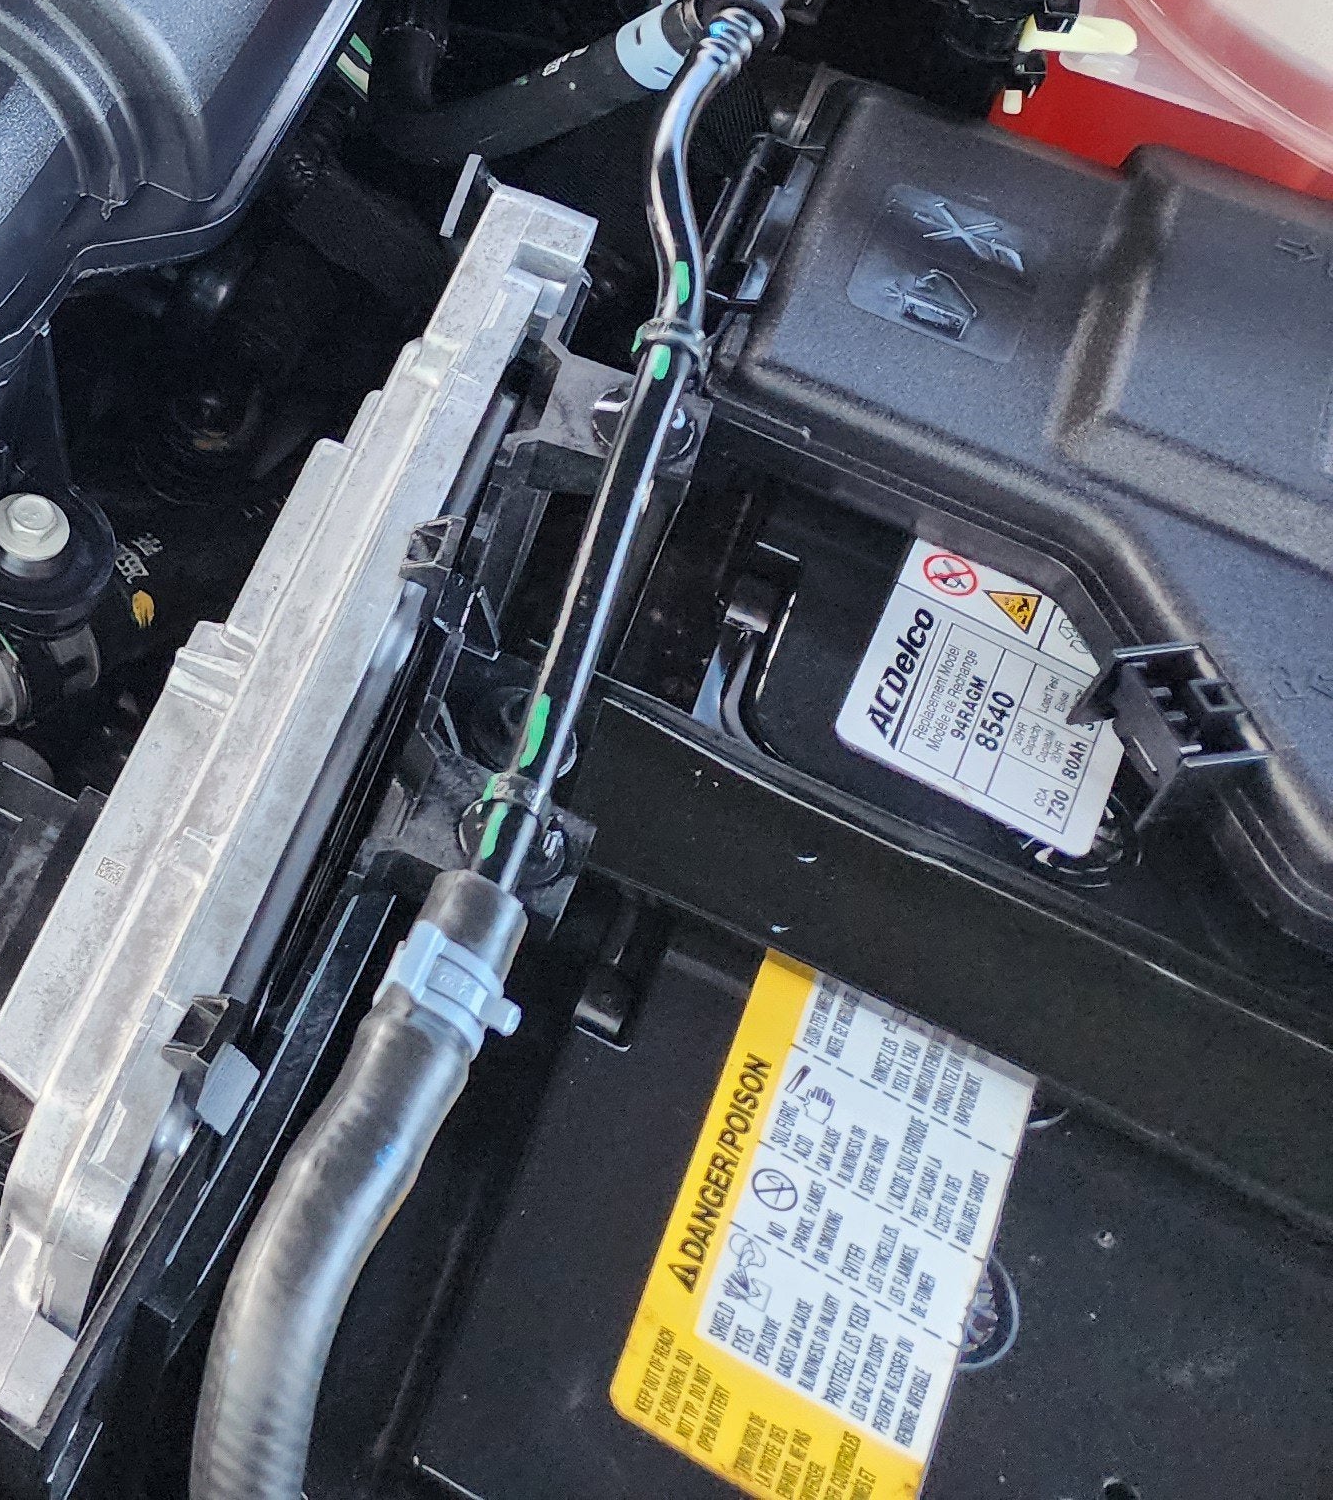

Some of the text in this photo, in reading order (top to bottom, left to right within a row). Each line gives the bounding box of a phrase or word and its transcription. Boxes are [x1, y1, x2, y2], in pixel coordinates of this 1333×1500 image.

[868, 609, 933, 735] ACDelco
[912, 643, 960, 739] Replacement Model
[947, 649, 977, 699] Rechange
[942, 699, 956, 713] de
[950, 675, 986, 739] 94RAGM
[1037, 675, 1059, 713] Load Test
[975, 691, 1014, 750] 8540
[1011, 721, 1027, 745] 20HR
[1021, 722, 1043, 755] Capacity
[1061, 741, 1087, 779] 80Ah
[1033, 787, 1049, 806] CCA
[1046, 789, 1069, 818] 730
[870, 1036, 899, 1083] RINCEZ LES
[900, 1039, 920, 1065] L'EAU
[891, 1069, 911, 1092] YEUX
[932, 1067, 959, 1115] CONSULTEZ
[770, 1100, 799, 1147] SULFURIC
[681, 1054, 768, 1261] DANGER/POISON
[792, 1134, 813, 1159] ACID
[815, 1126, 841, 1170] CAN CAUSE
[837, 1124, 866, 1182] BLINDNESS OR
[858, 1135, 889, 1193] SEVERE BURNS
[888, 1116, 928, 1209] L'ACIDE SULFURIQUE
[803, 1180, 826, 1215] FLAMES
[910, 1197, 928, 1220] PEUT
[927, 1155, 941, 1169] LA
[940, 1190, 957, 1205] OU
[944, 1174, 961, 1192] DES
[967, 1170, 989, 1202] GRAVES
[767, 1221, 787, 1240] NO
[813, 1209, 842, 1264] OR SMOKING
[866, 1273, 883, 1293] LES
[888, 1285, 905, 1306] LES
[910, 1272, 934, 1318] DE FUMER
[708, 1301, 735, 1341] SHIELD
[848, 1302, 869, 1331] YEUX
[731, 1324, 754, 1354] EYES
[753, 1316, 780, 1365] EXPLOSIVE
[775, 1298, 812, 1377] GASES CAN CAUSE
[798, 1293, 838, 1390] BLINDNESS OR INJURY
[841, 1330, 862, 1354] LES
[642, 1368, 660, 1390] OUT
[648, 1354, 664, 1371] OF
[693, 1363, 711, 1387] NOT
[850, 1334, 887, 1421] LES GAZ EXPLOSIFS
[634, 1387, 653, 1414] KEEP
[654, 1409, 671, 1427] OF
[675, 1349, 693, 1366] DO
[688, 1383, 706, 1401] DO
[872, 1339, 913, 1432] PEUVENT BLESSER OU
[696, 1383, 729, 1452] OPEN BATTERY
[894, 1368, 931, 1446] RENDRE AVEUGLE
[675, 1415, 694, 1440] NOT
